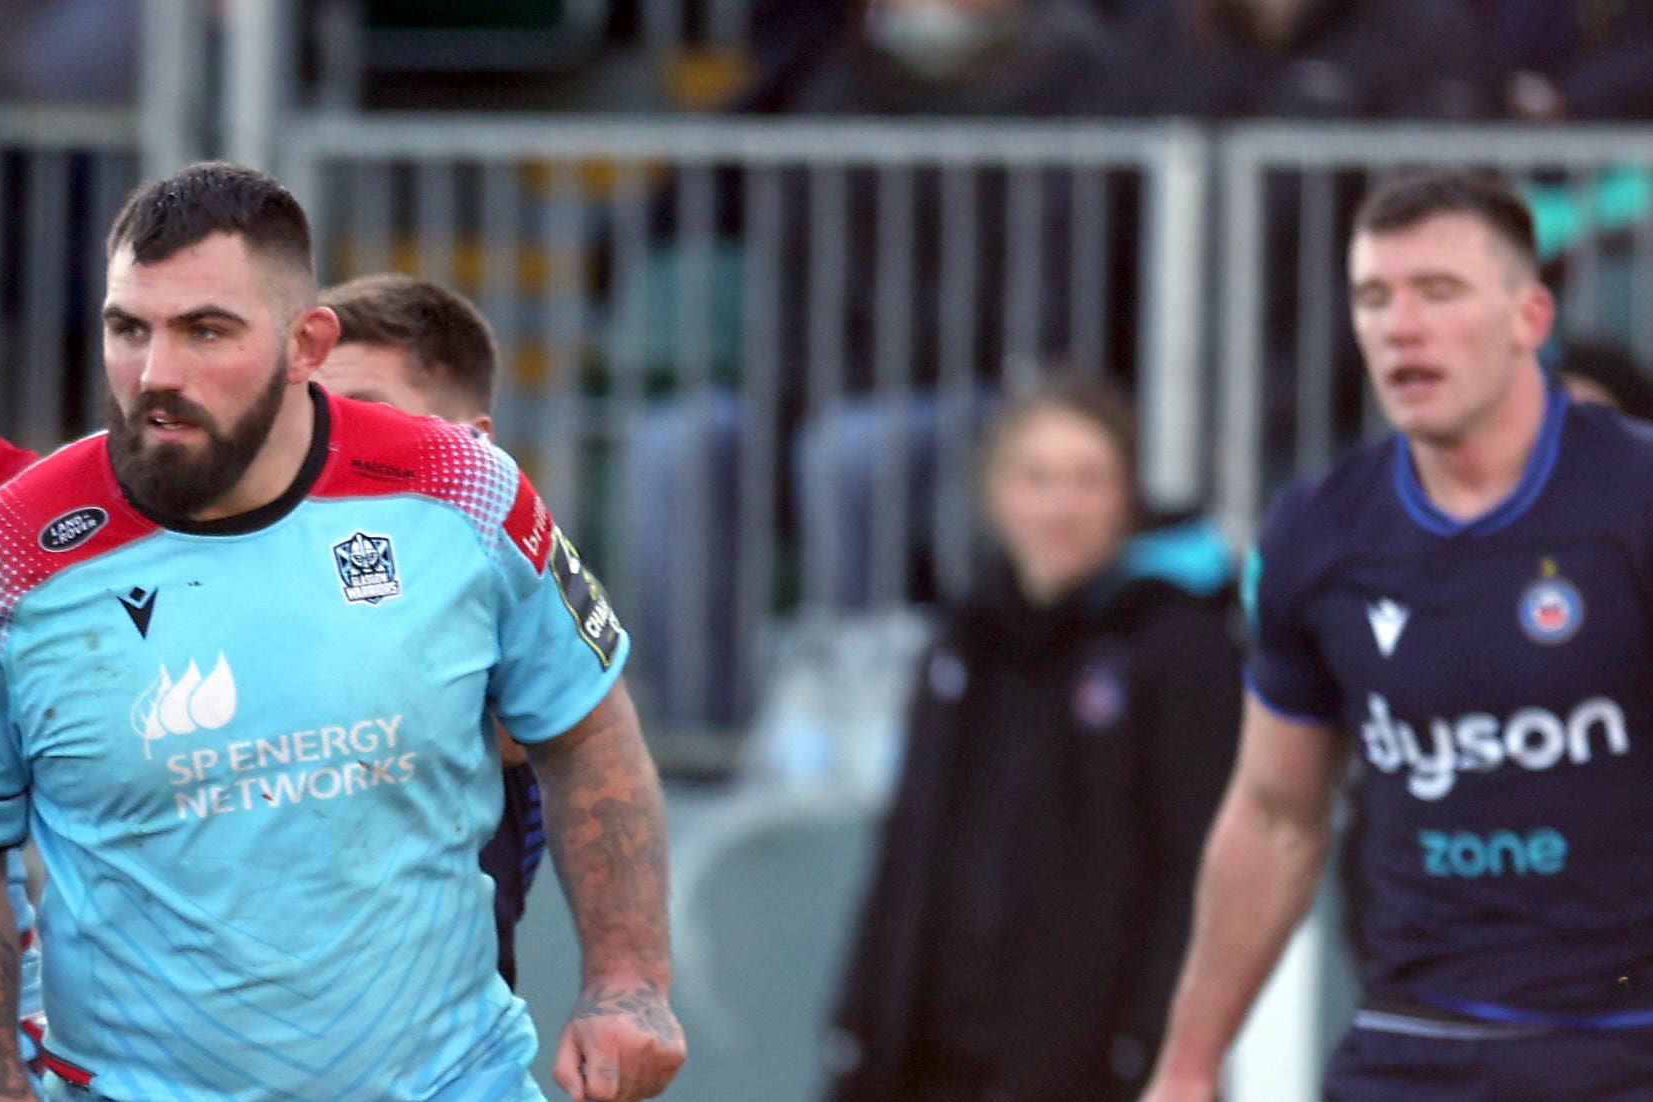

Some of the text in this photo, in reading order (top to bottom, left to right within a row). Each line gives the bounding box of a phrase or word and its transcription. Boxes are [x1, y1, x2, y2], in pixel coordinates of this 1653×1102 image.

[51, 516, 82, 536] LAND
[59, 519, 97, 544] ROVER
[167, 714, 403, 786] SP ENERGY
[1361, 692, 1631, 801] dyson
[175, 752, 417, 820] NETWORKS
[1418, 827, 1569, 879] zone
